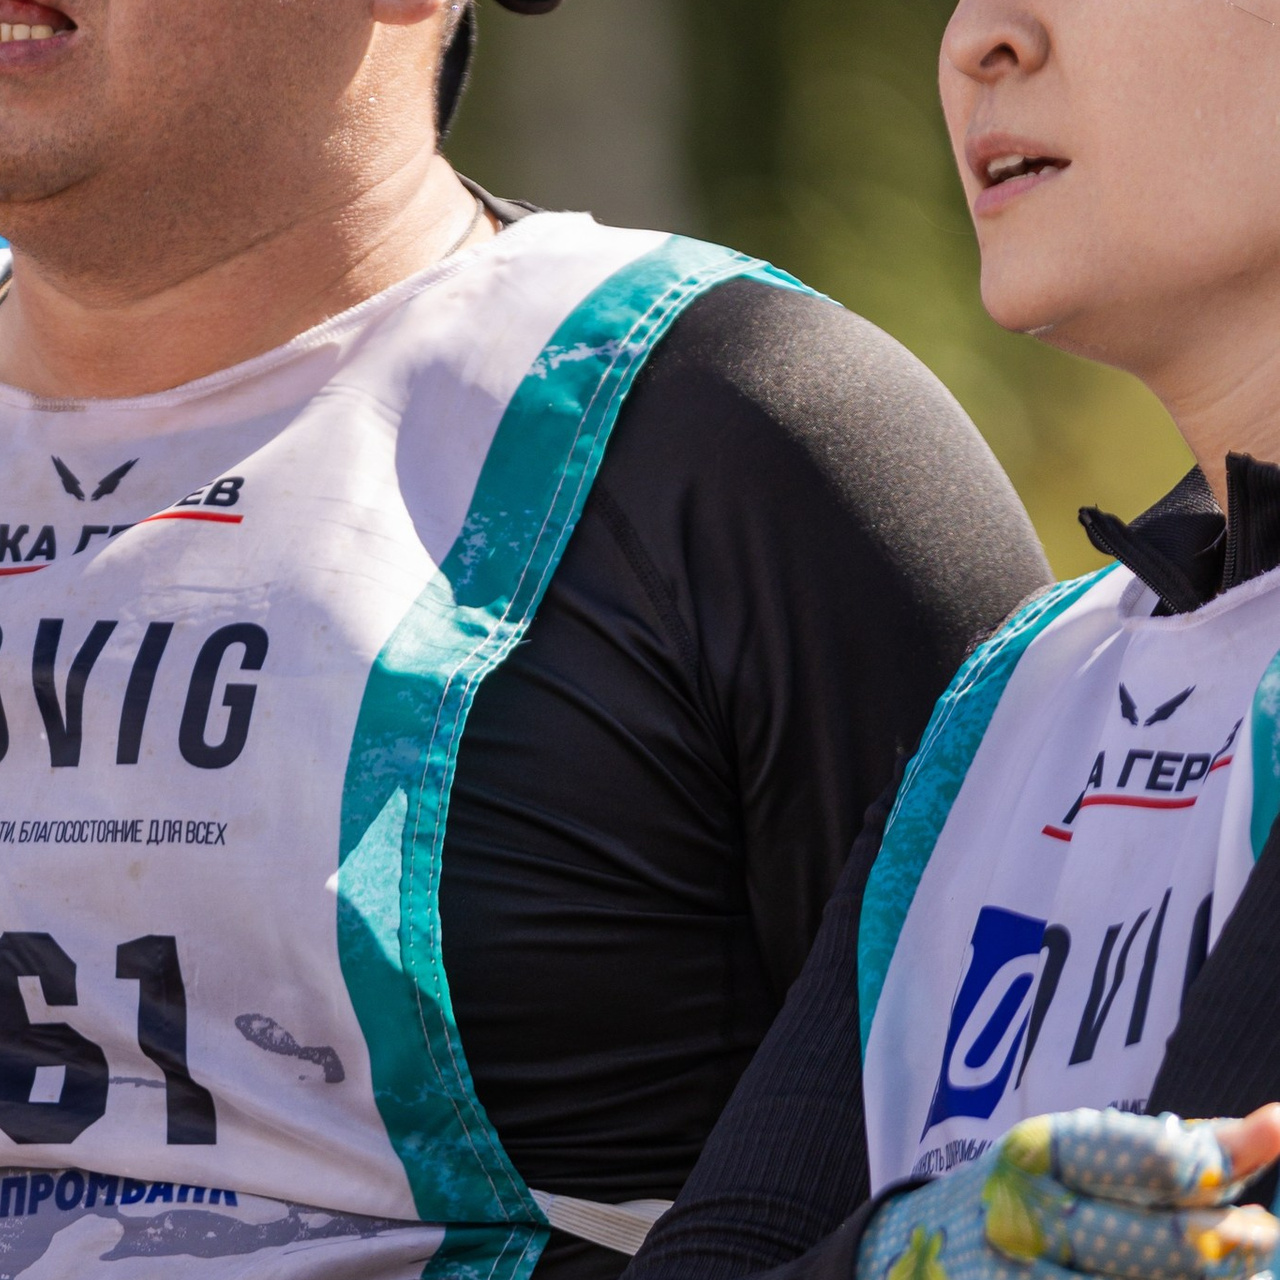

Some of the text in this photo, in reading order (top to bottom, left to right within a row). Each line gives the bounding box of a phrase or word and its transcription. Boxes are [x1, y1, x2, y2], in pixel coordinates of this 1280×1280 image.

[72, 476, 245, 556] ГЕВ
[18, 819, 144, 843] БЛАГОСОСТОЯНИЕ
[146, 819, 183, 846] ДЛЯ
[185, 821, 228, 846] ВСЕХ
